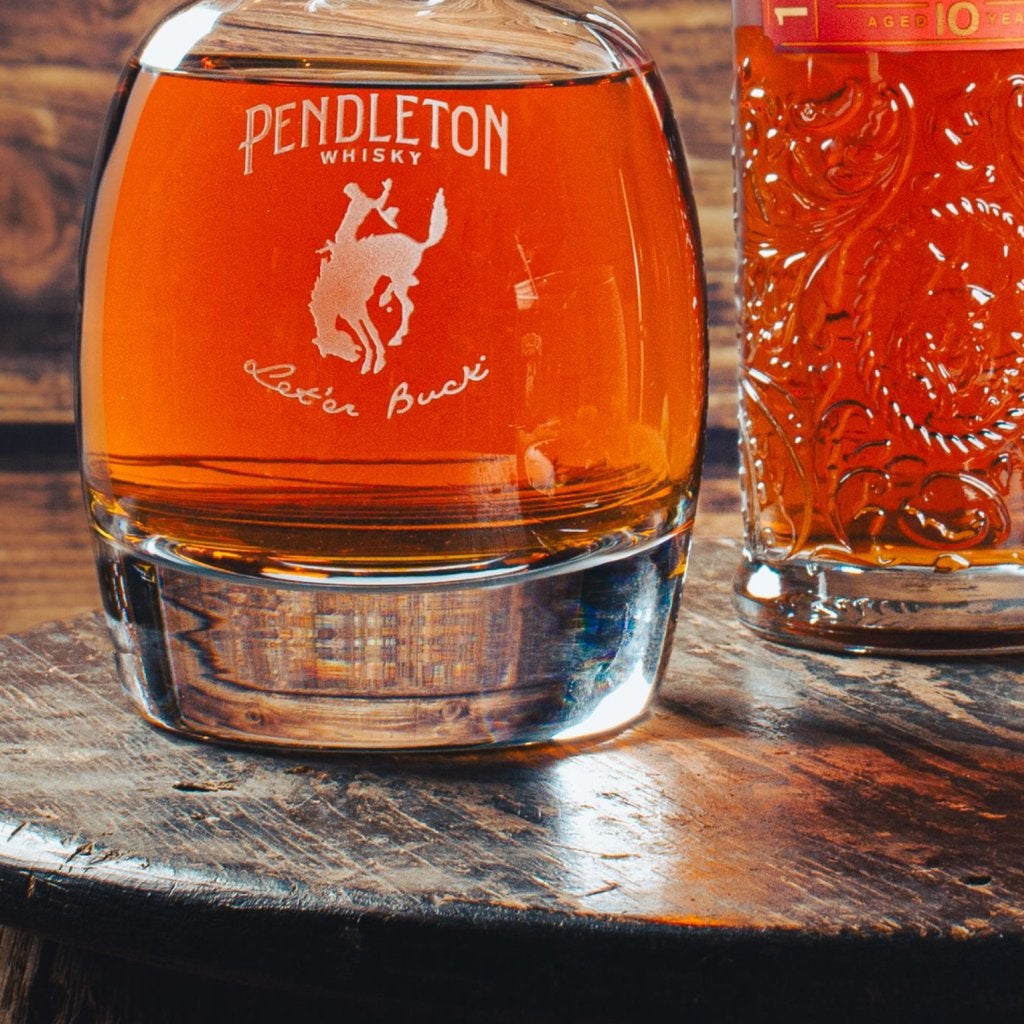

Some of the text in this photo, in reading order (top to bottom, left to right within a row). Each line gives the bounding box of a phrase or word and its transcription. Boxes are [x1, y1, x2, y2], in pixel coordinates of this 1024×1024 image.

[867, 15, 928, 28] AGED
[935, 0, 980, 37] 10
[238, 93, 510, 176] PENDLETON
[320, 149, 422, 166] WHISKY
[386, 355, 490, 419] Buck
